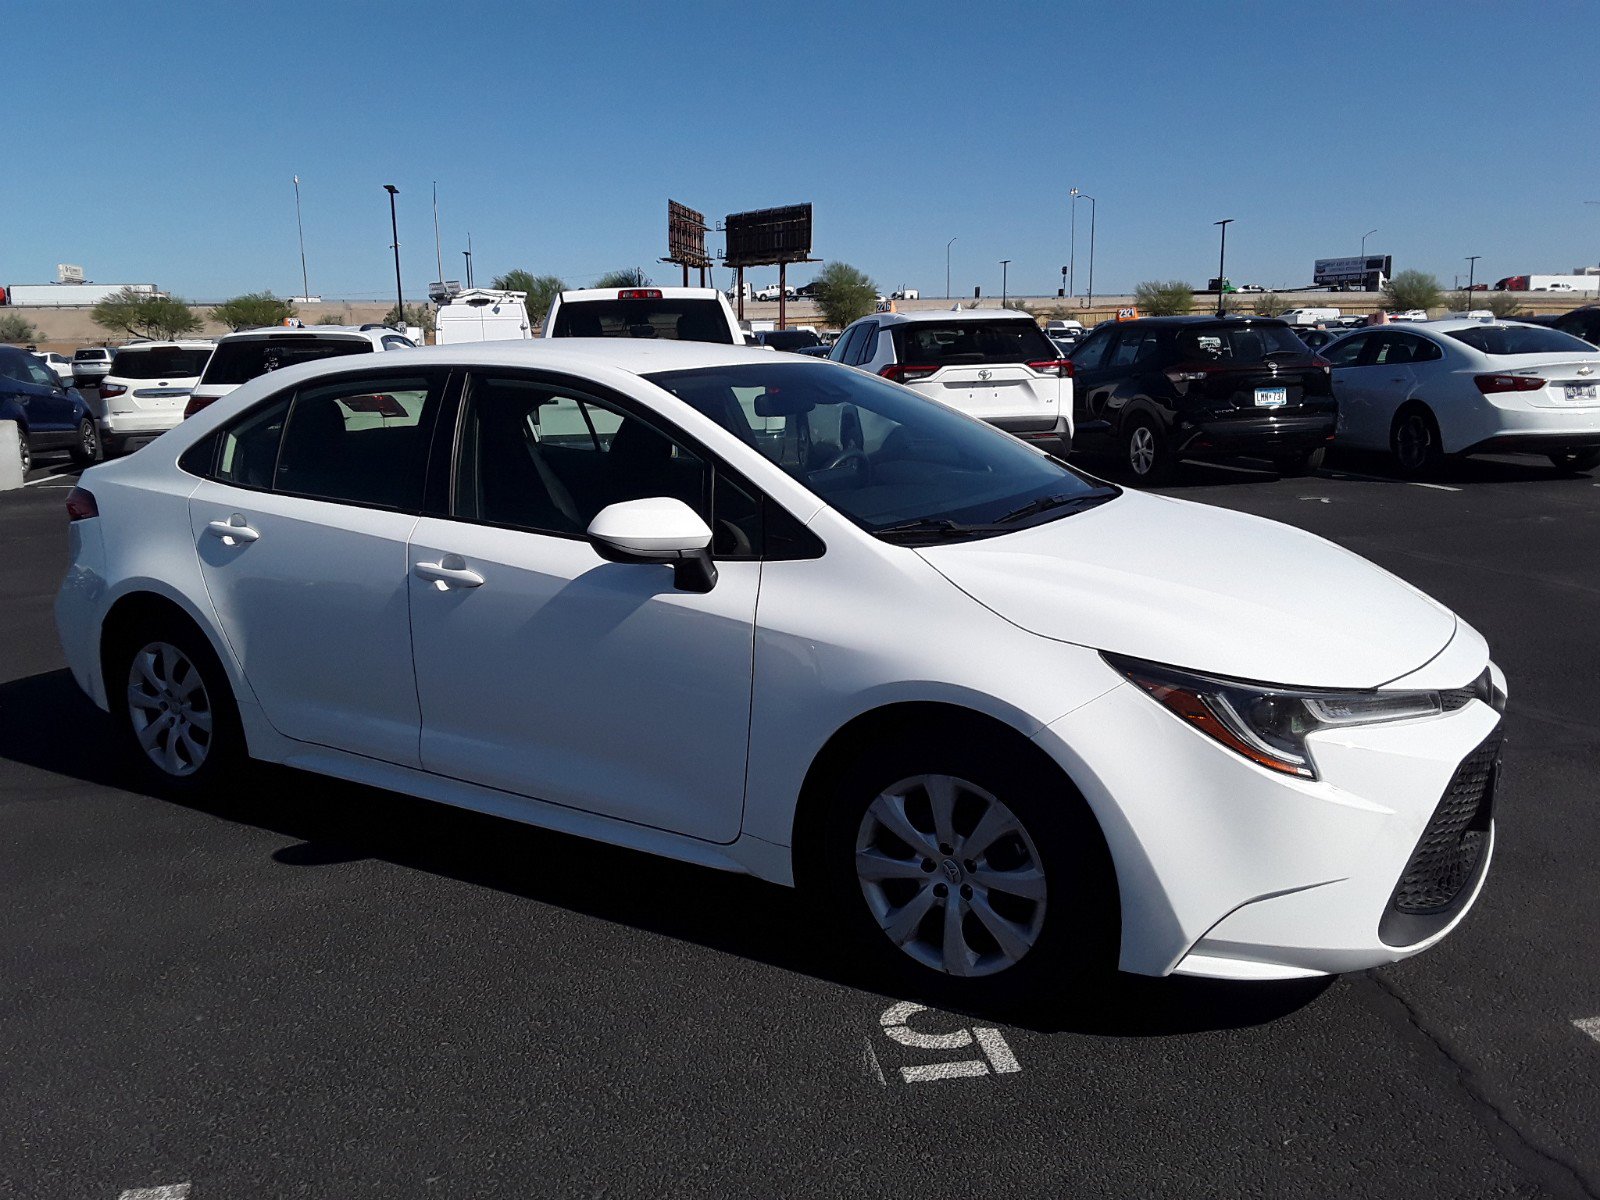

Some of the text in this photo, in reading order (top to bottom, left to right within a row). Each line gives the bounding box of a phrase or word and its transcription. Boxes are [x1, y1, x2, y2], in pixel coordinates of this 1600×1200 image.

[877, 302, 891, 312] 2216
[1118, 308, 1135, 318] 2321
[1273, 392, 1284, 400] 737
